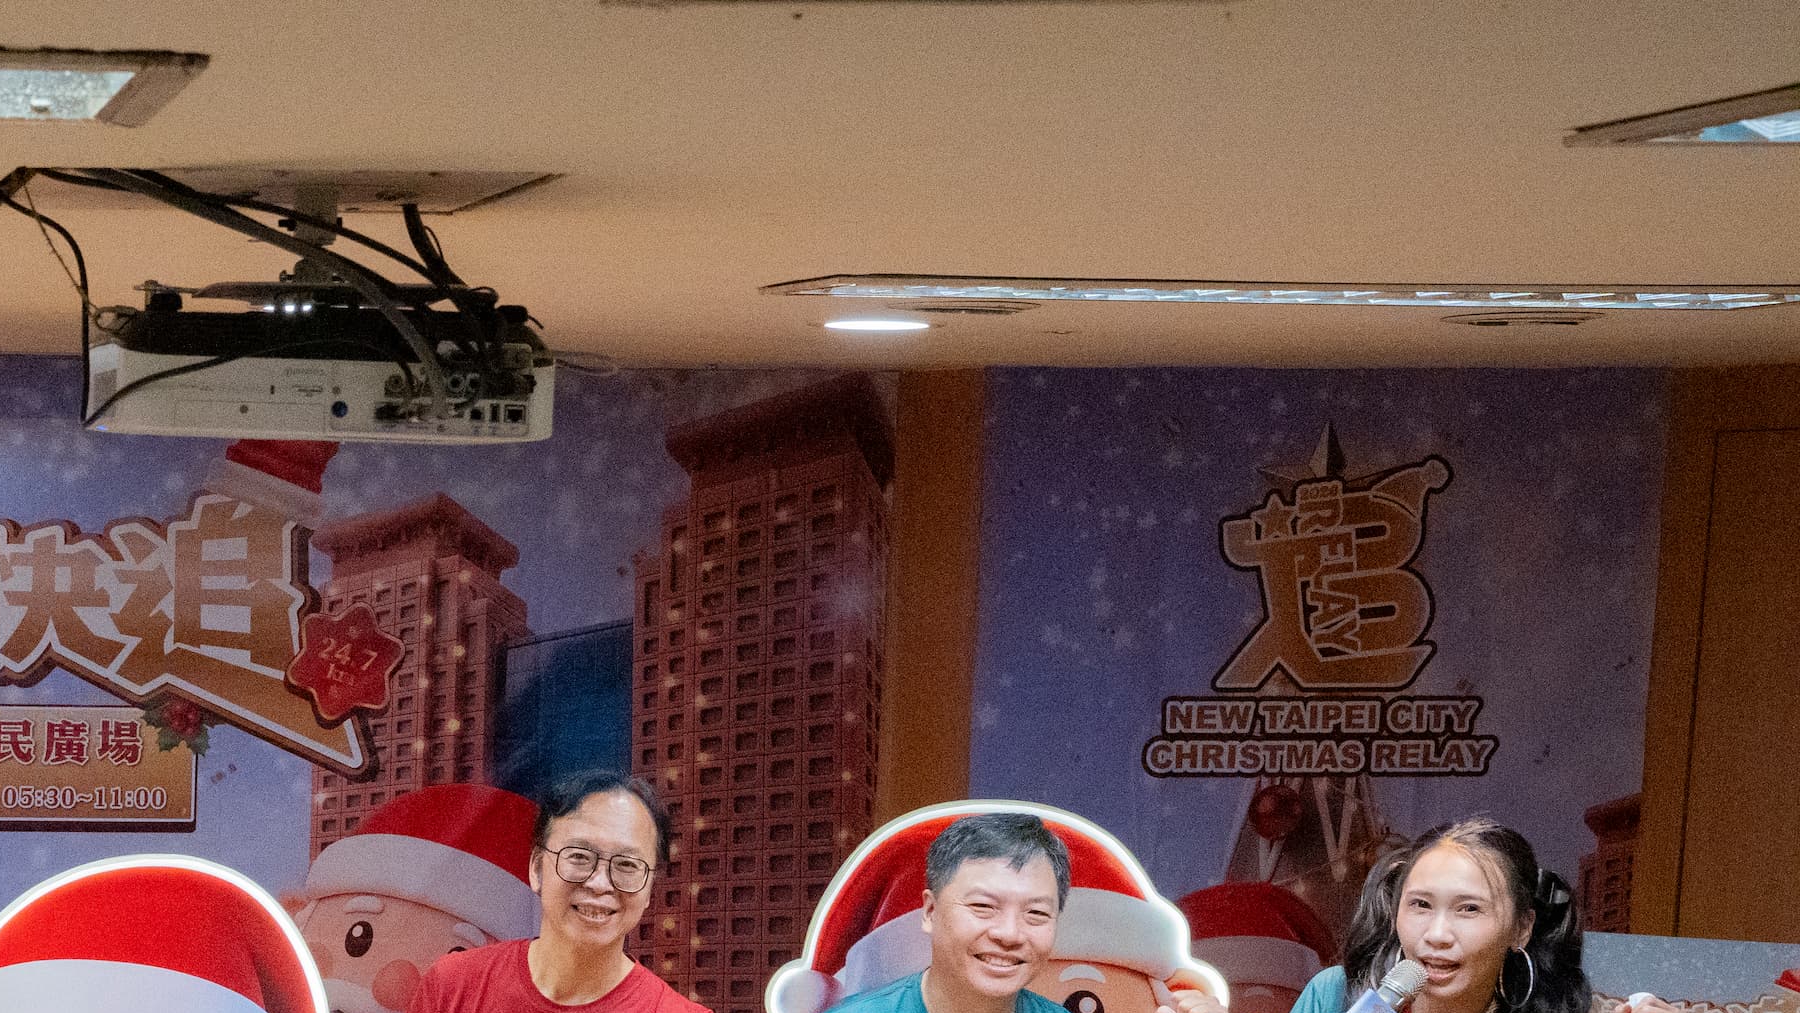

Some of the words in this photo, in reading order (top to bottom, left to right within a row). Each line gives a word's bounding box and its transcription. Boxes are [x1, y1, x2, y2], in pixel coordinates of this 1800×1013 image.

[1167, 703, 1253, 731] NEW
[1261, 703, 1379, 731] TAIPEI
[1388, 703, 1476, 730] CITY
[1149, 741, 1365, 771] CHRISTMAS
[1374, 742, 1492, 770] RELAY
[0, 784, 168, 810] 05:30~11:00
